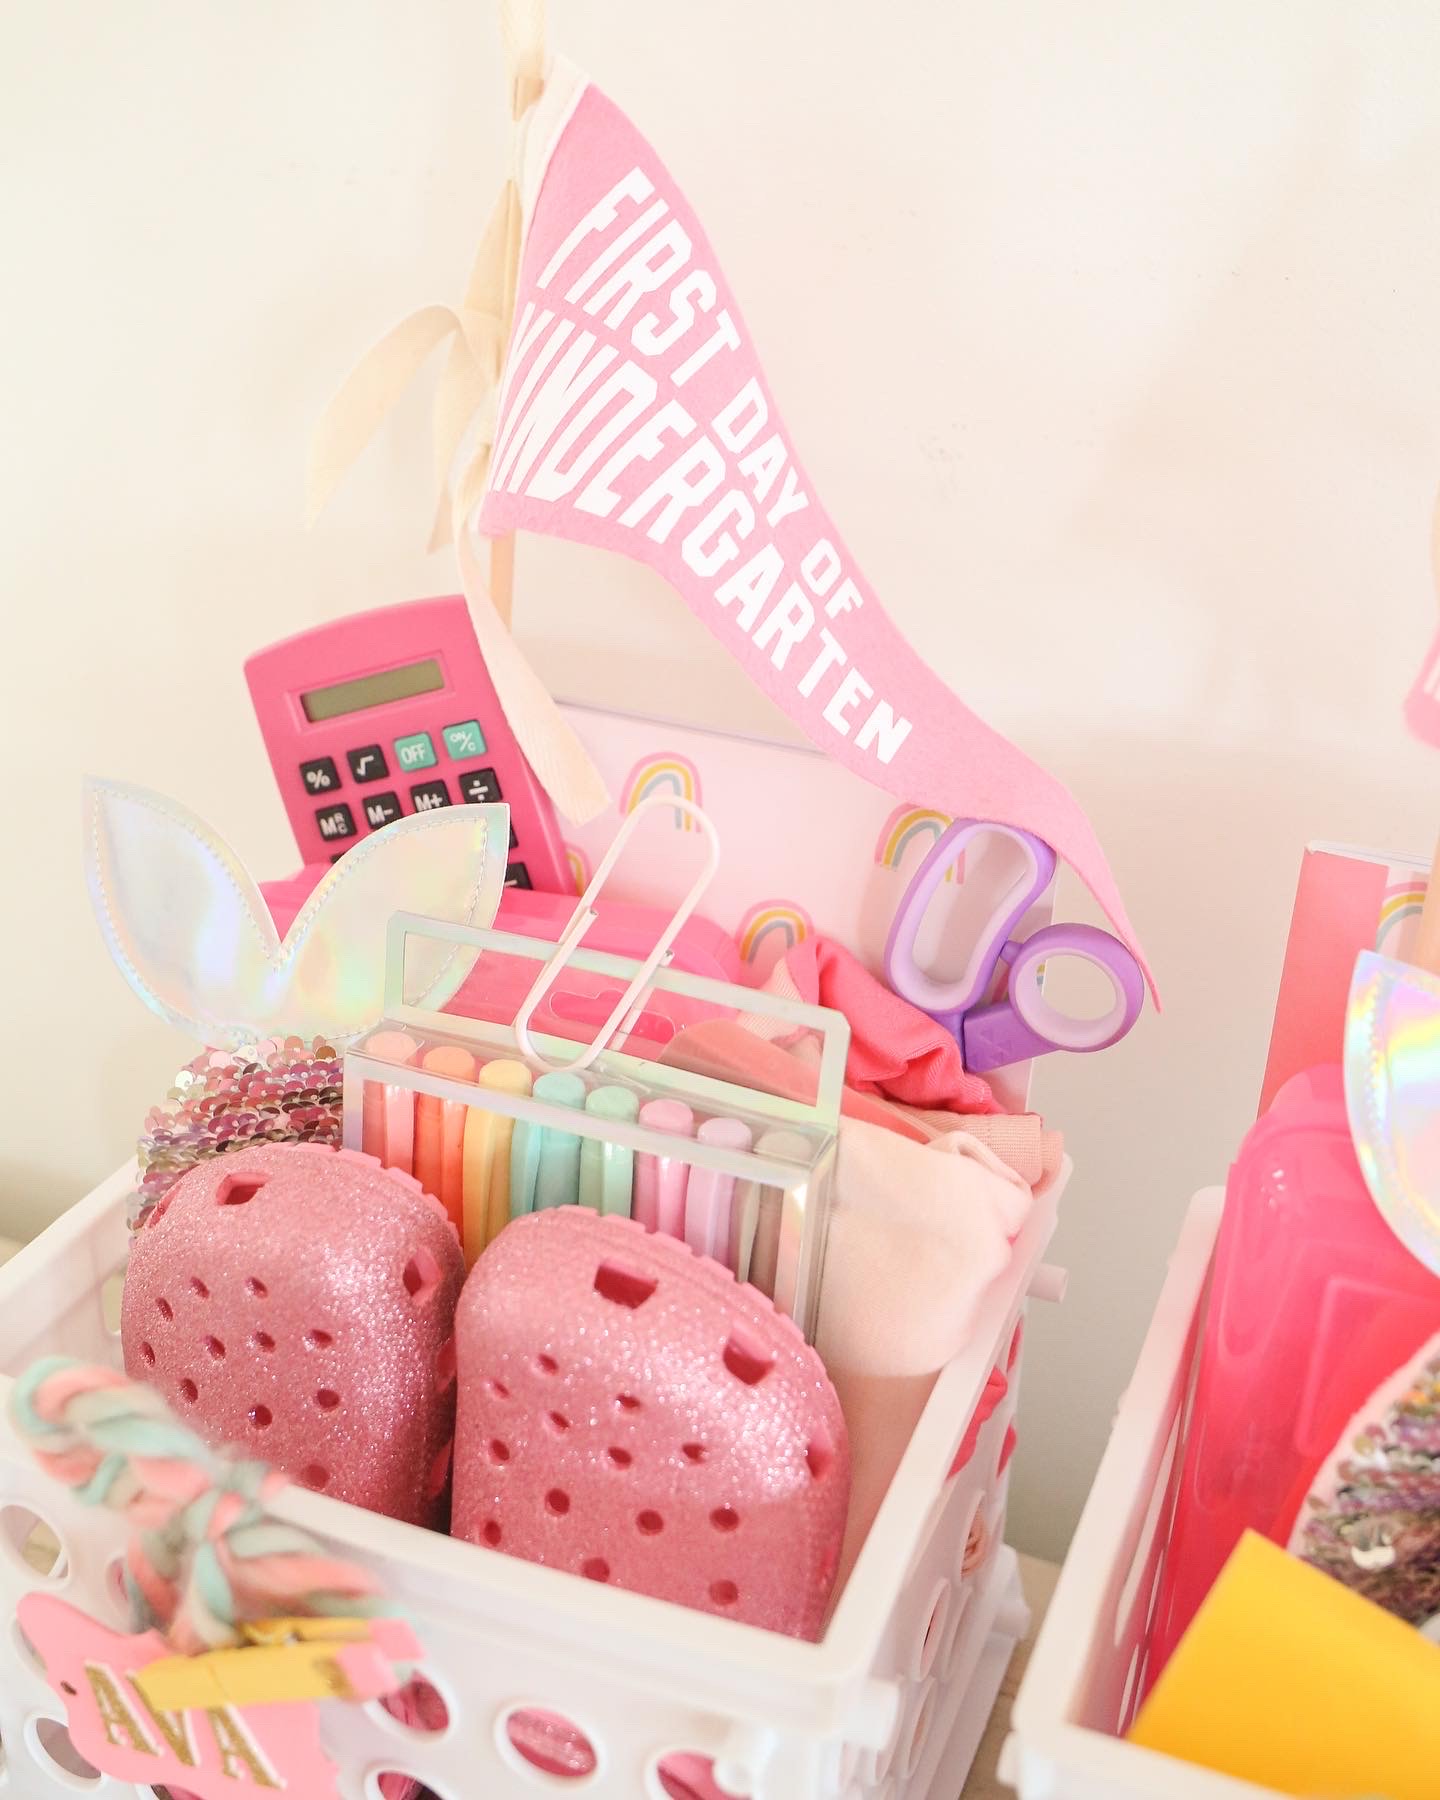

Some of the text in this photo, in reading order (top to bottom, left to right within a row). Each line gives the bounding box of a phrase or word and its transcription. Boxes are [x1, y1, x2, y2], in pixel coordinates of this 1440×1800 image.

[536, 166, 864, 618] FIRST DAY OF
[400, 743, 426, 764] OFF
